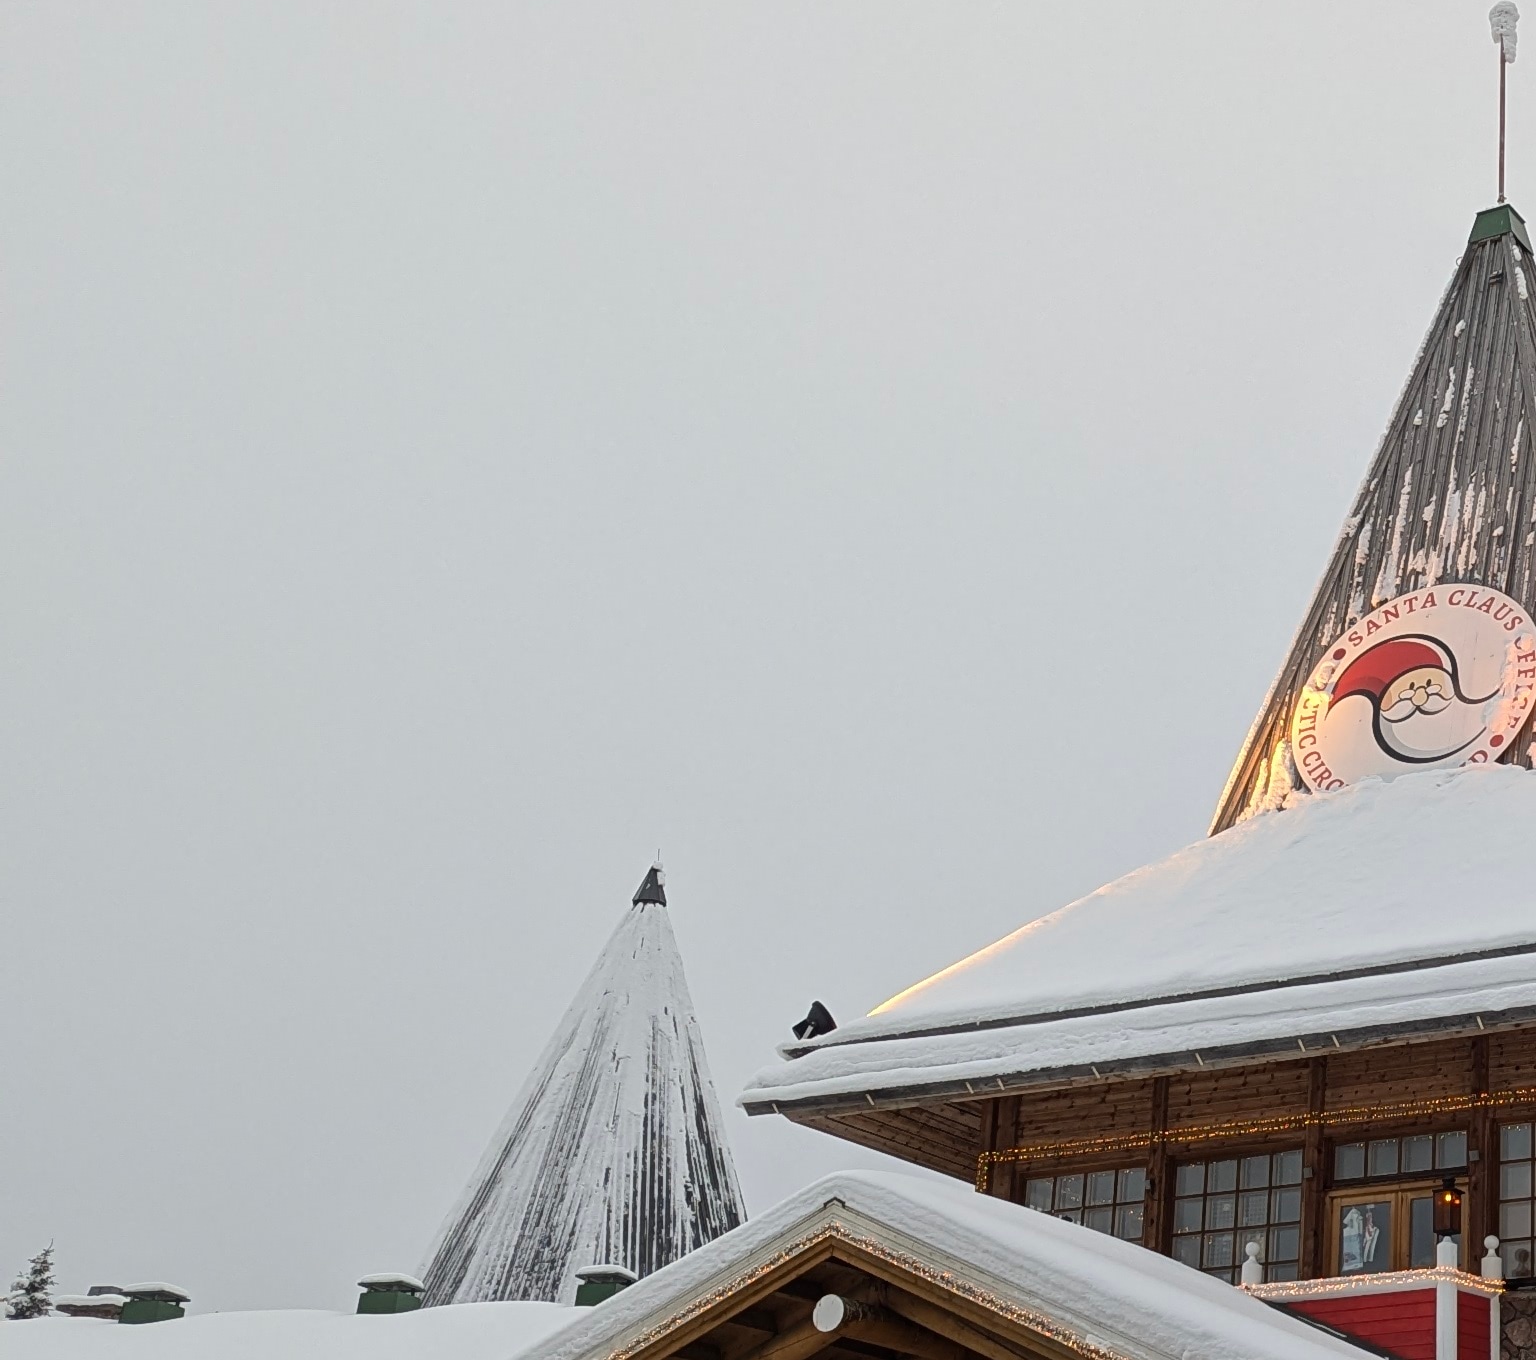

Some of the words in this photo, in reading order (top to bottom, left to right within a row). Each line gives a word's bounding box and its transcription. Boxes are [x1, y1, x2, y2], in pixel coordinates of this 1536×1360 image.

[1348, 592, 1437, 647] SANTA
[1448, 590, 1524, 631] CLAUS
[1303, 751, 1349, 791] CIRC
